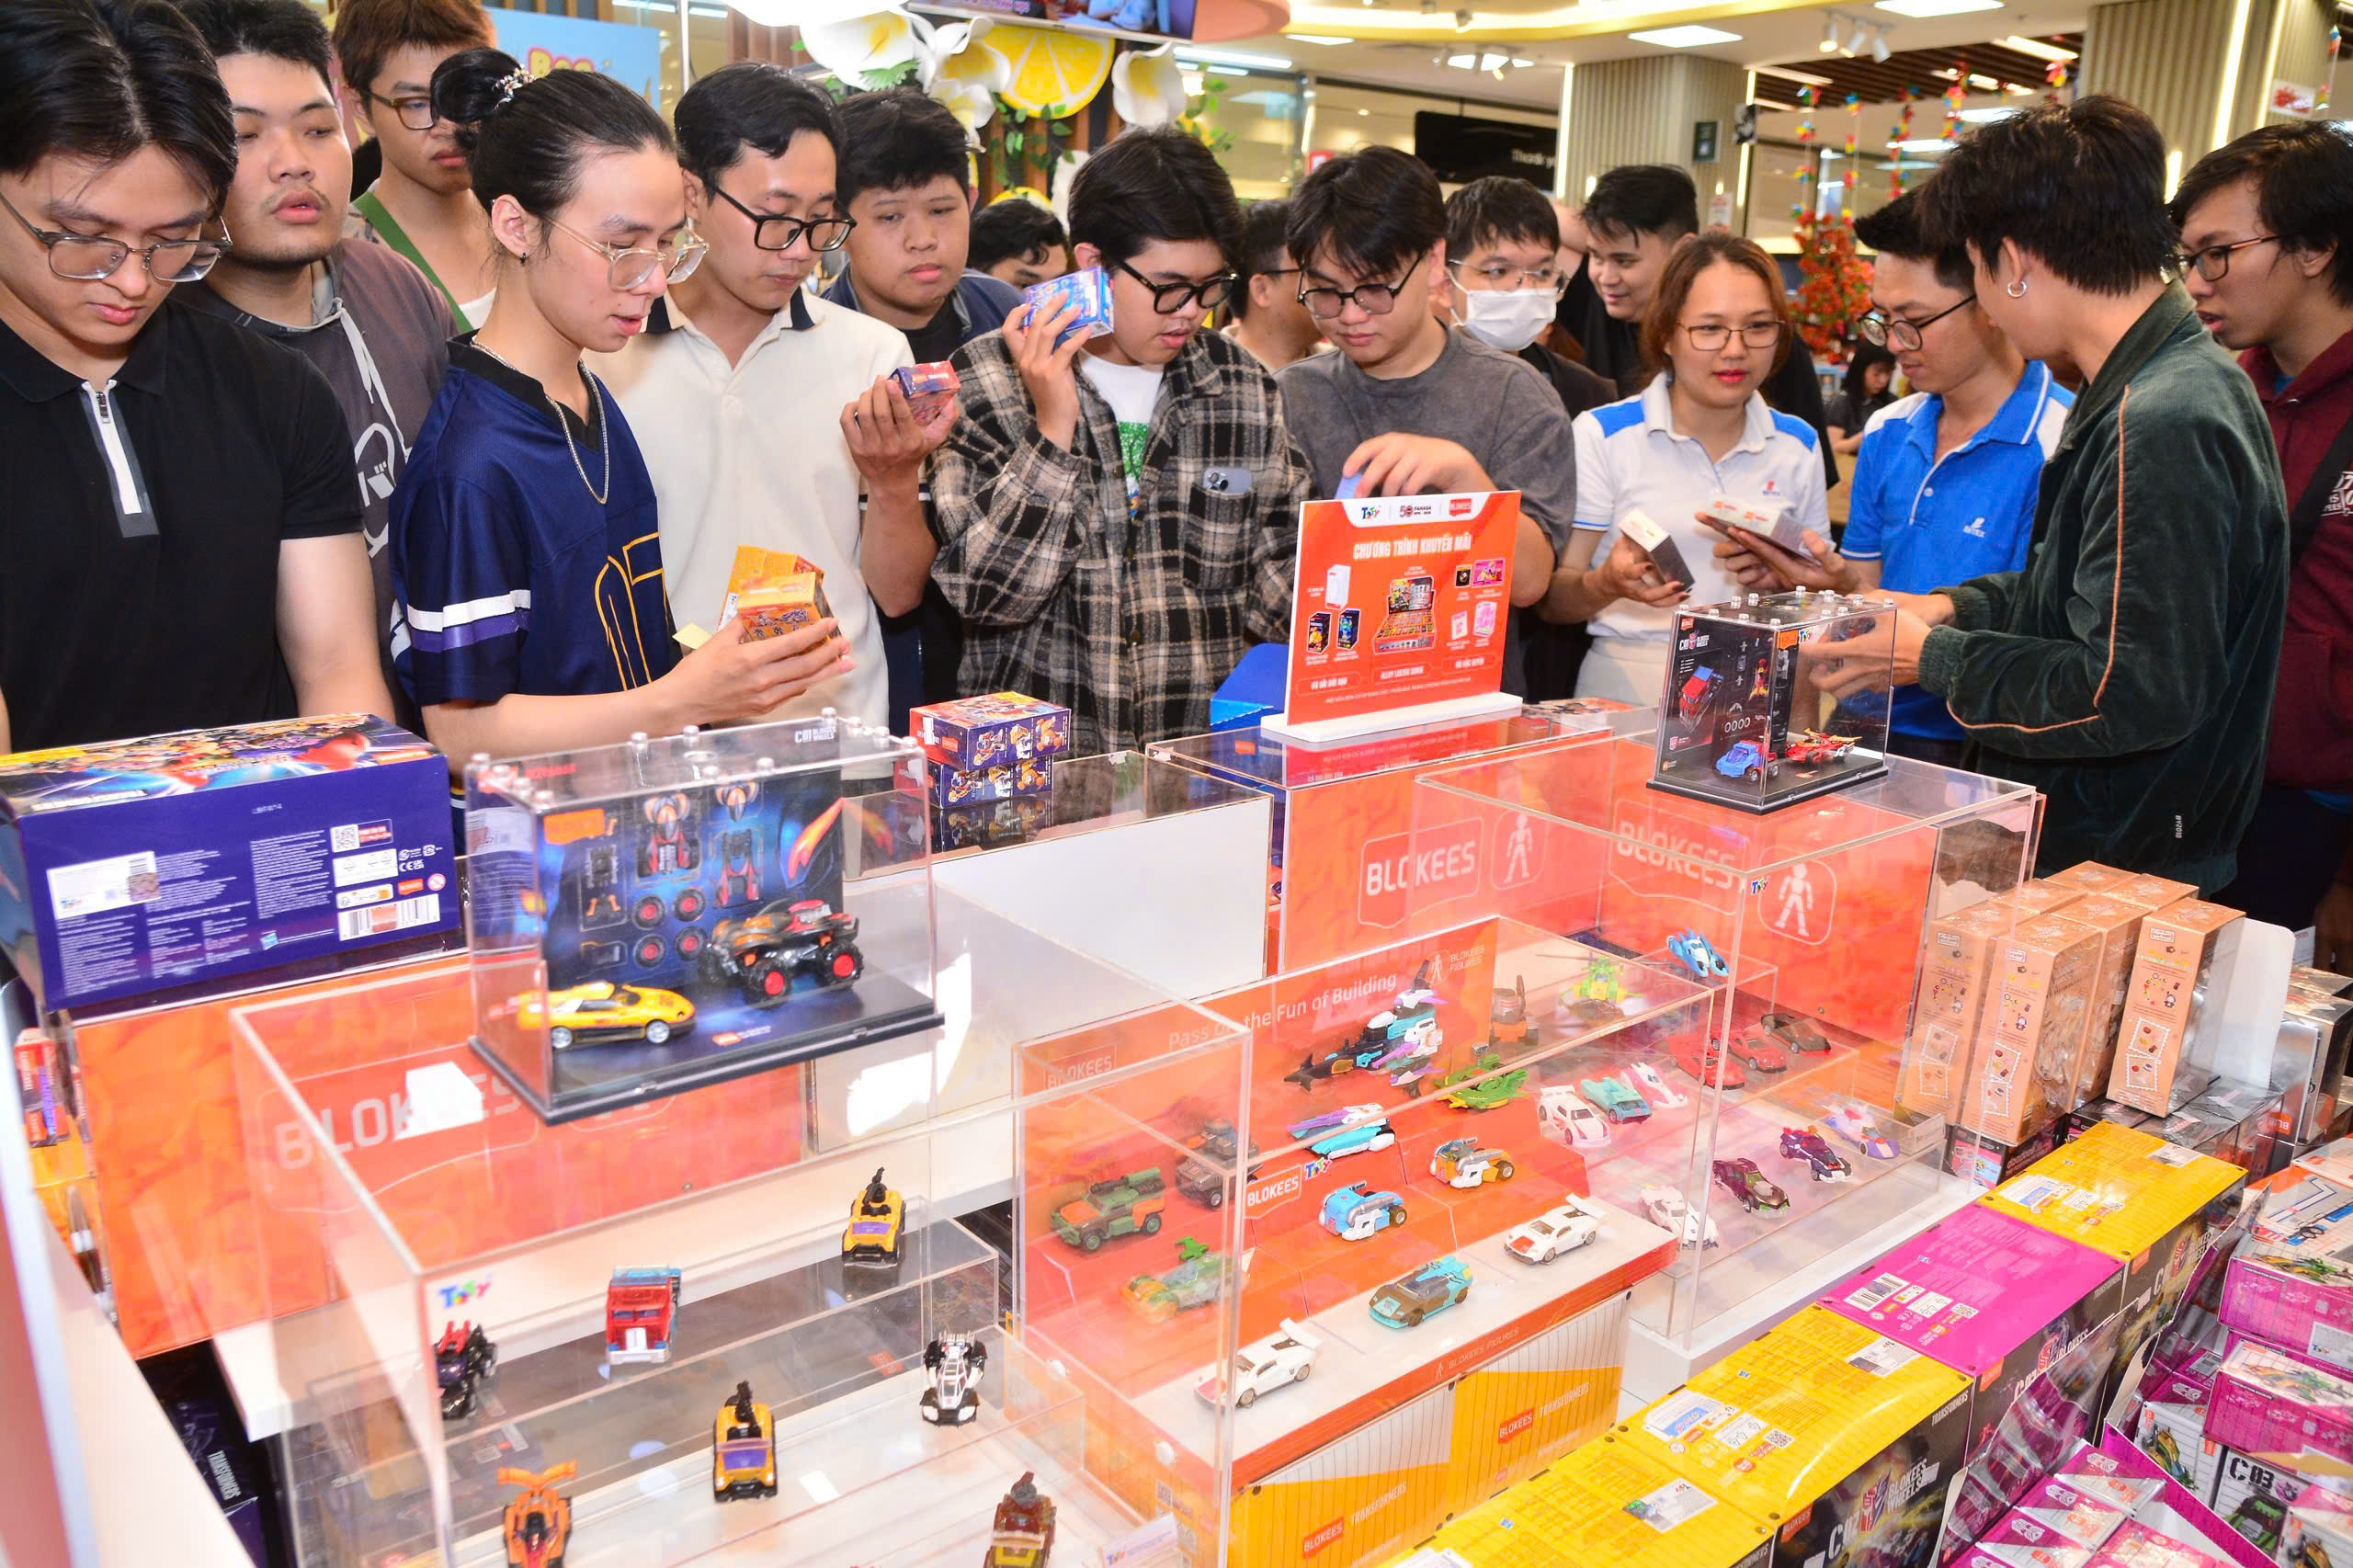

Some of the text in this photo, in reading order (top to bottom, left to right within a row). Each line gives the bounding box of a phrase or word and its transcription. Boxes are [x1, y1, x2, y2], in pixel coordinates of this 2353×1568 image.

[1353, 538, 1390, 560] CHƯƠNG
[1393, 535, 1417, 557] TRÌNH
[1367, 840, 1475, 896] BLOKEES
[1449, 955, 1483, 973] FIGURES
[1450, 945, 1485, 963] BLOKEES
[1168, 1028, 1210, 1051] Pass
[1243, 1010, 1272, 1030] the
[1276, 998, 1307, 1023] Fun
[1312, 989, 1331, 1011] of
[1333, 972, 1397, 1005] Building
[1247, 1176, 1299, 1207] BLOKEES
[1448, 1327, 1520, 1369] BLOKEES FIGURES
[1539, 1381, 1590, 1418] TRANSFORMERS
[1931, 1390, 1969, 1426] TRANSFORMERS
[1499, 1413, 1533, 1438] BLOKEES
[207, 1449, 242, 1501] TRANSFORMERS
[1889, 1458, 1927, 1495] BLOKEES
[1350, 1481, 1407, 1527] TRANSFORMERS
[1887, 1476, 1923, 1515] WHEELS
[1303, 1520, 1344, 1552] BLOKEES
